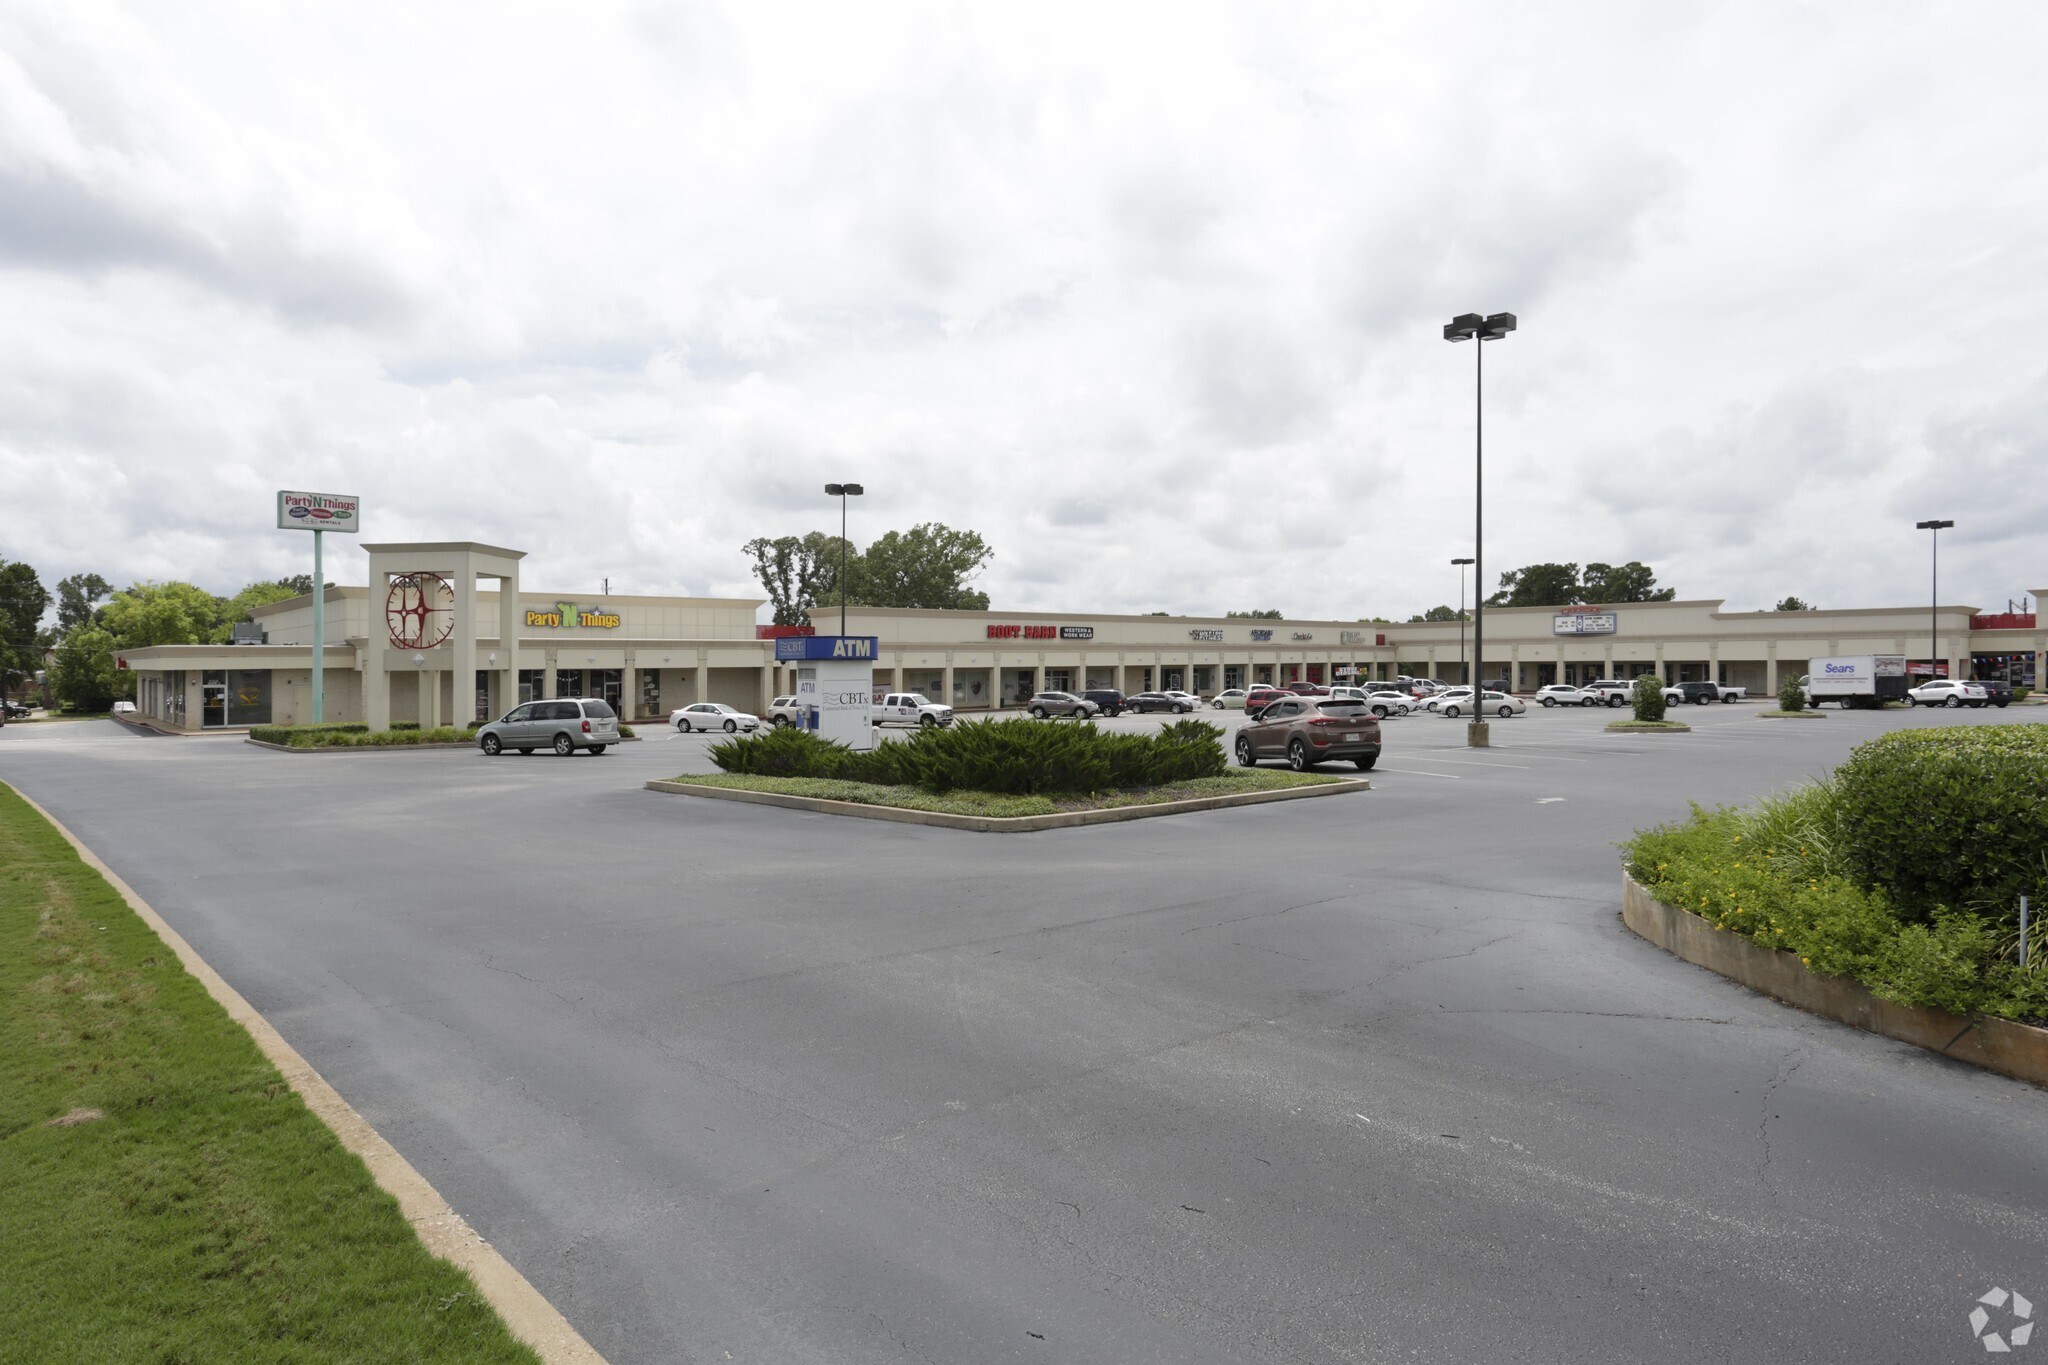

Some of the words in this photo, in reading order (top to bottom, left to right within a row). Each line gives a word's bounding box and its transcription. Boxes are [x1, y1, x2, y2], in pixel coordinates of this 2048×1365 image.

[285, 495, 312, 507] Party
[323, 498, 356, 511] Things
[526, 611, 560, 628] Party
[580, 611, 620, 628] Things
[988, 625, 1021, 638] BOOT
[1024, 626, 1056, 639] BARN
[833, 639, 870, 657] ATM
[1825, 663, 1855, 673] Sears
[801, 682, 815, 693] ATM
